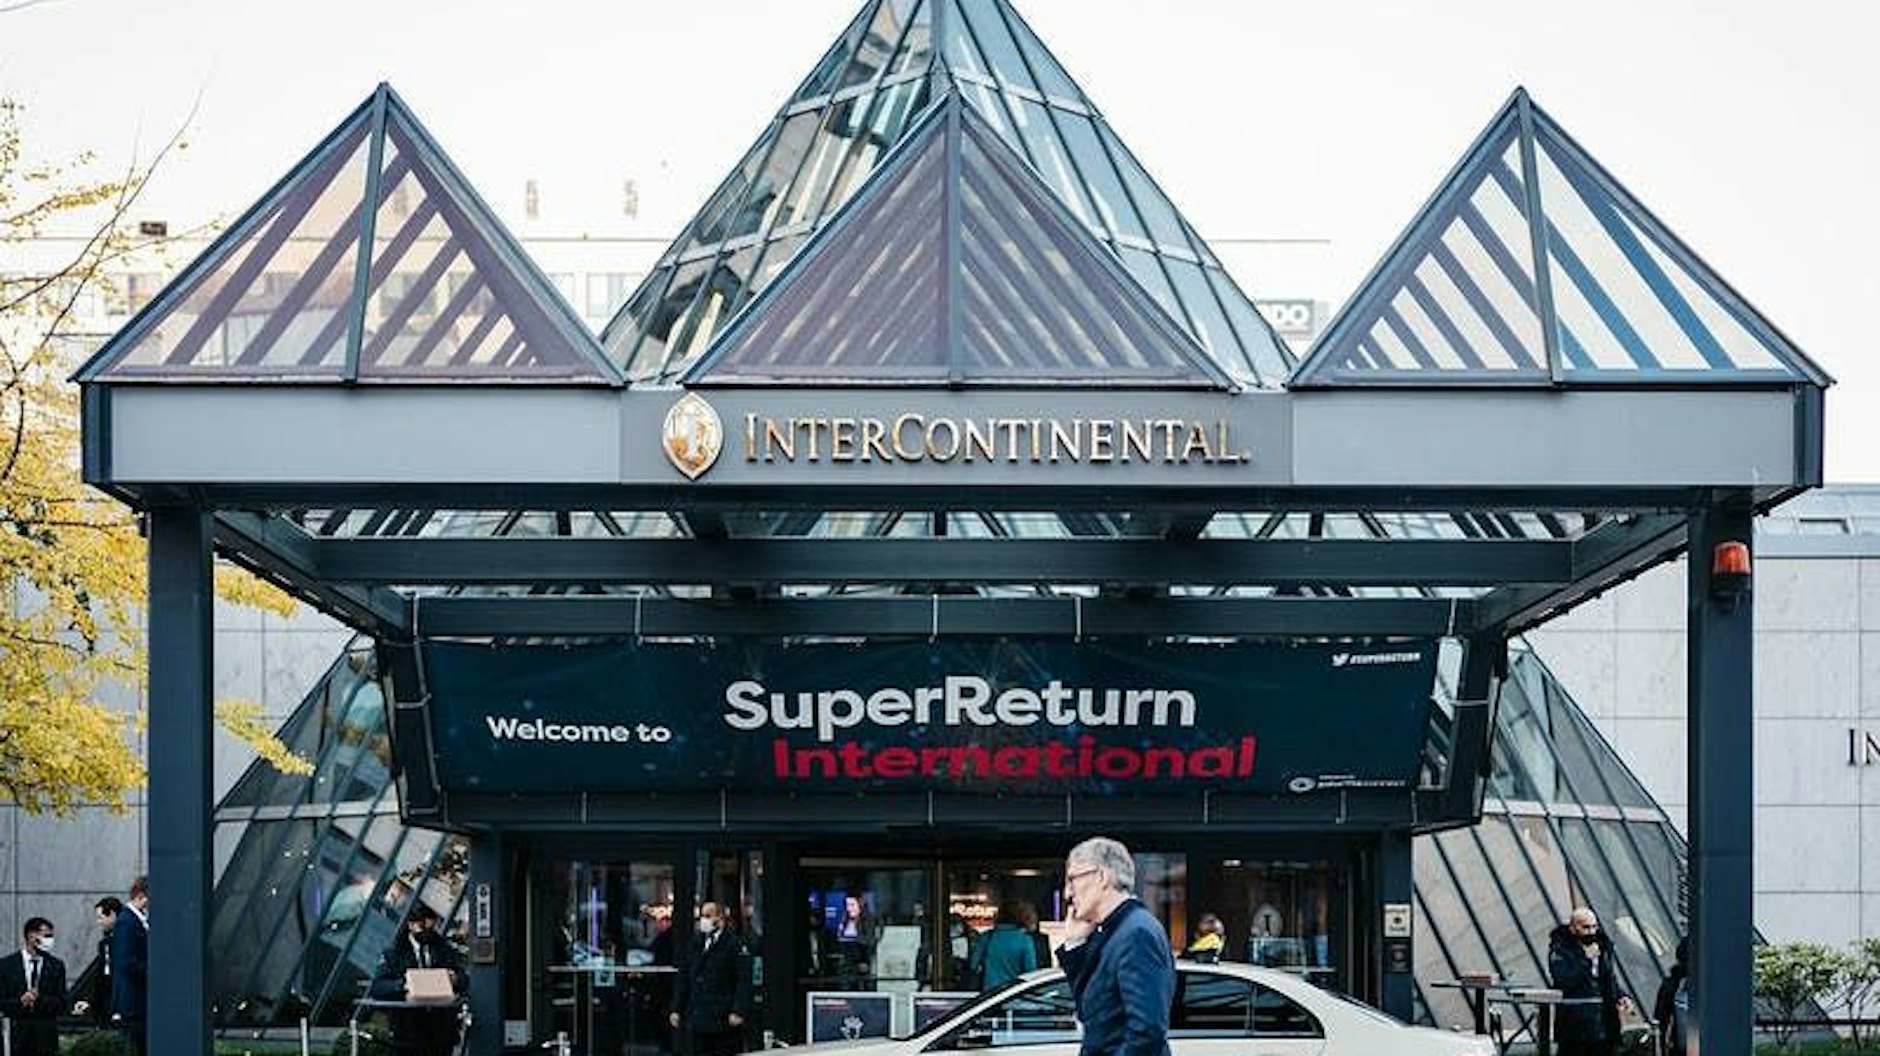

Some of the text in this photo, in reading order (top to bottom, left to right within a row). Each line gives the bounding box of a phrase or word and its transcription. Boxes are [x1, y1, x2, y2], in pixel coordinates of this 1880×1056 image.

[486, 716, 672, 743] Welcome to
[724, 676, 1196, 741] SuperReturn
[773, 736, 1256, 780] International
